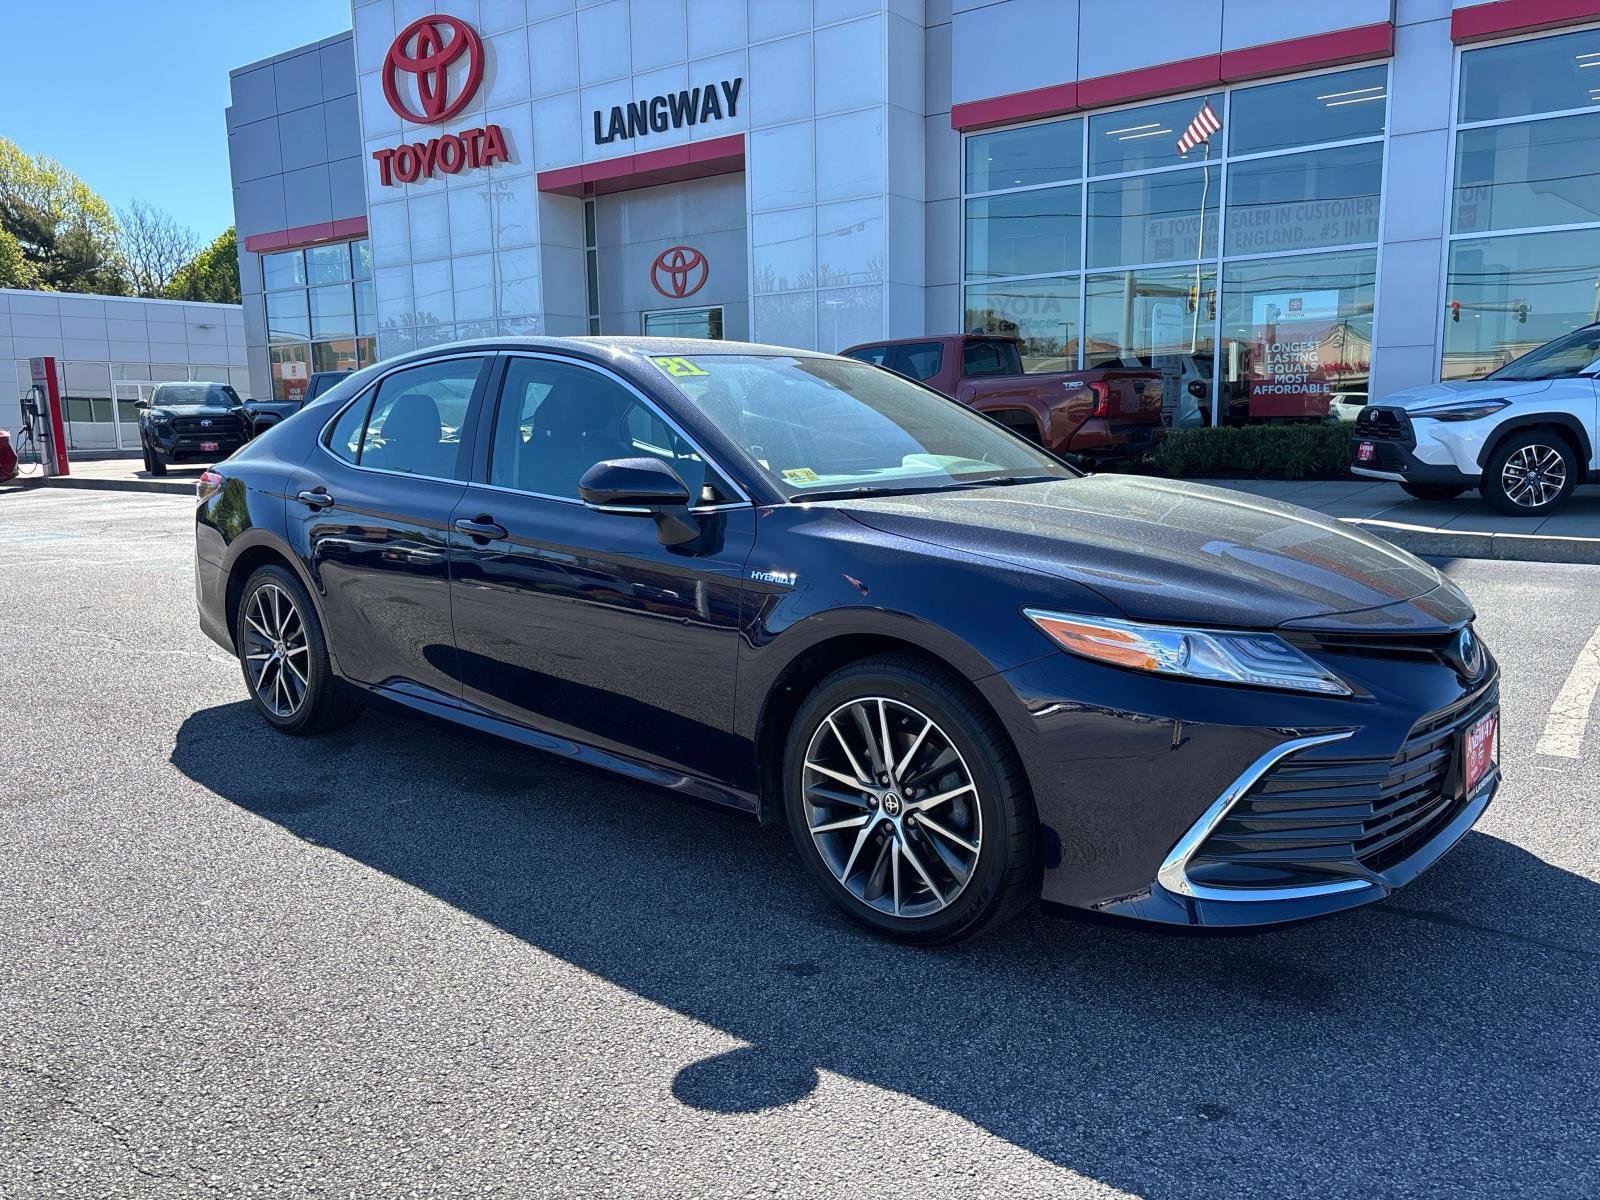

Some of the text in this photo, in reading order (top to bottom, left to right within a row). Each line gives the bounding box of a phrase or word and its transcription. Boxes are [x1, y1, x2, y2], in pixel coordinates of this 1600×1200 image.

[594, 78, 742, 145] LANGWAY
[372, 124, 509, 186] TOYOTA
[1148, 223, 1164, 237] #1
[1229, 209, 1271, 229] EALER
[1275, 207, 1291, 225] IN
[1295, 199, 1373, 222] CUSTOMER
[1320, 222, 1339, 241] #5
[1344, 219, 1361, 238] IN
[1265, 341, 1320, 353] LONGEST
[1267, 352, 1318, 364] LASTING
[655, 357, 710, 376] 21
[1267, 363, 1318, 374] EQUALS
[1274, 373, 1309, 384] MOST
[1253, 383, 1330, 395] AFFORDABLE
